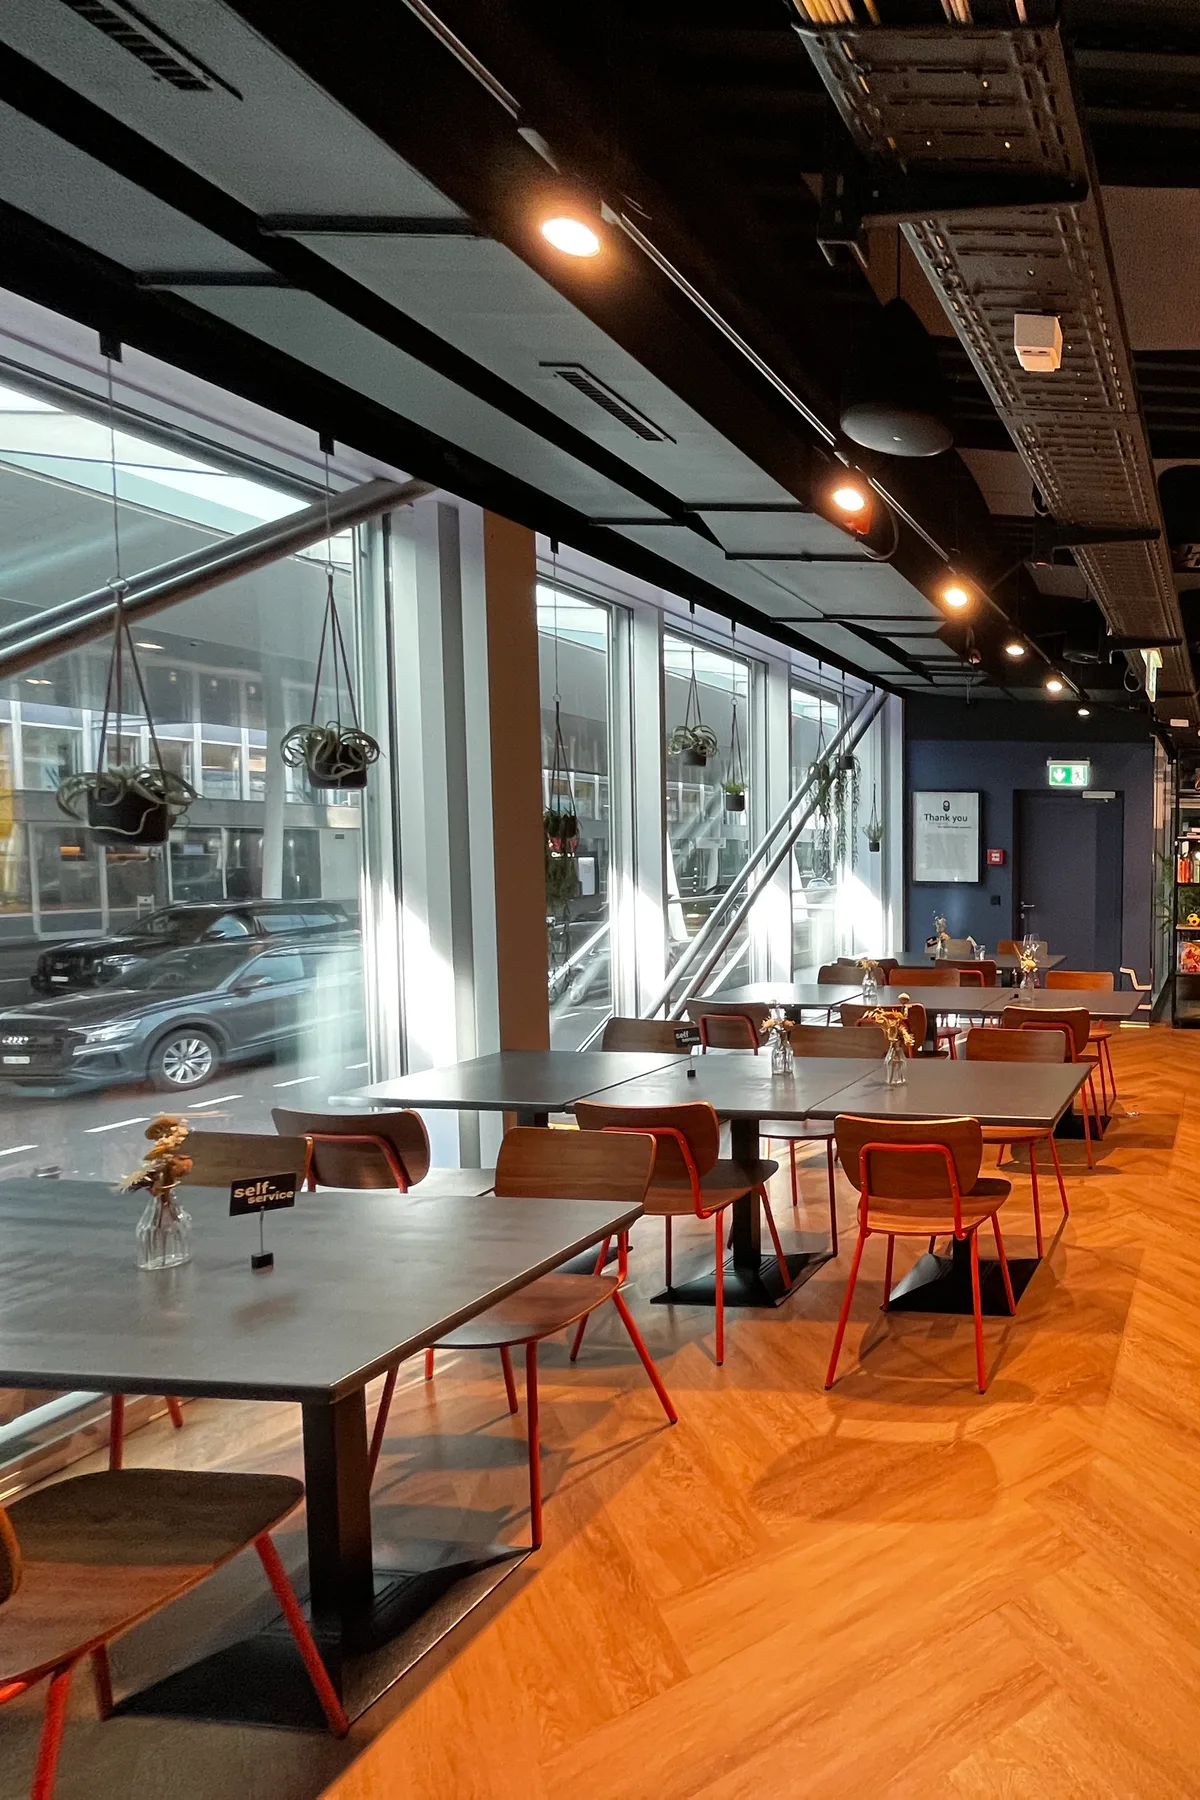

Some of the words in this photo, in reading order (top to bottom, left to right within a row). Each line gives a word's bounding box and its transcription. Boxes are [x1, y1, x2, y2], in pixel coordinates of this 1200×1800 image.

[924, 813, 950, 822] Thank
[952, 815, 968, 824] you
[233, 1180, 276, 1198] self-
[247, 1190, 294, 1205] service
